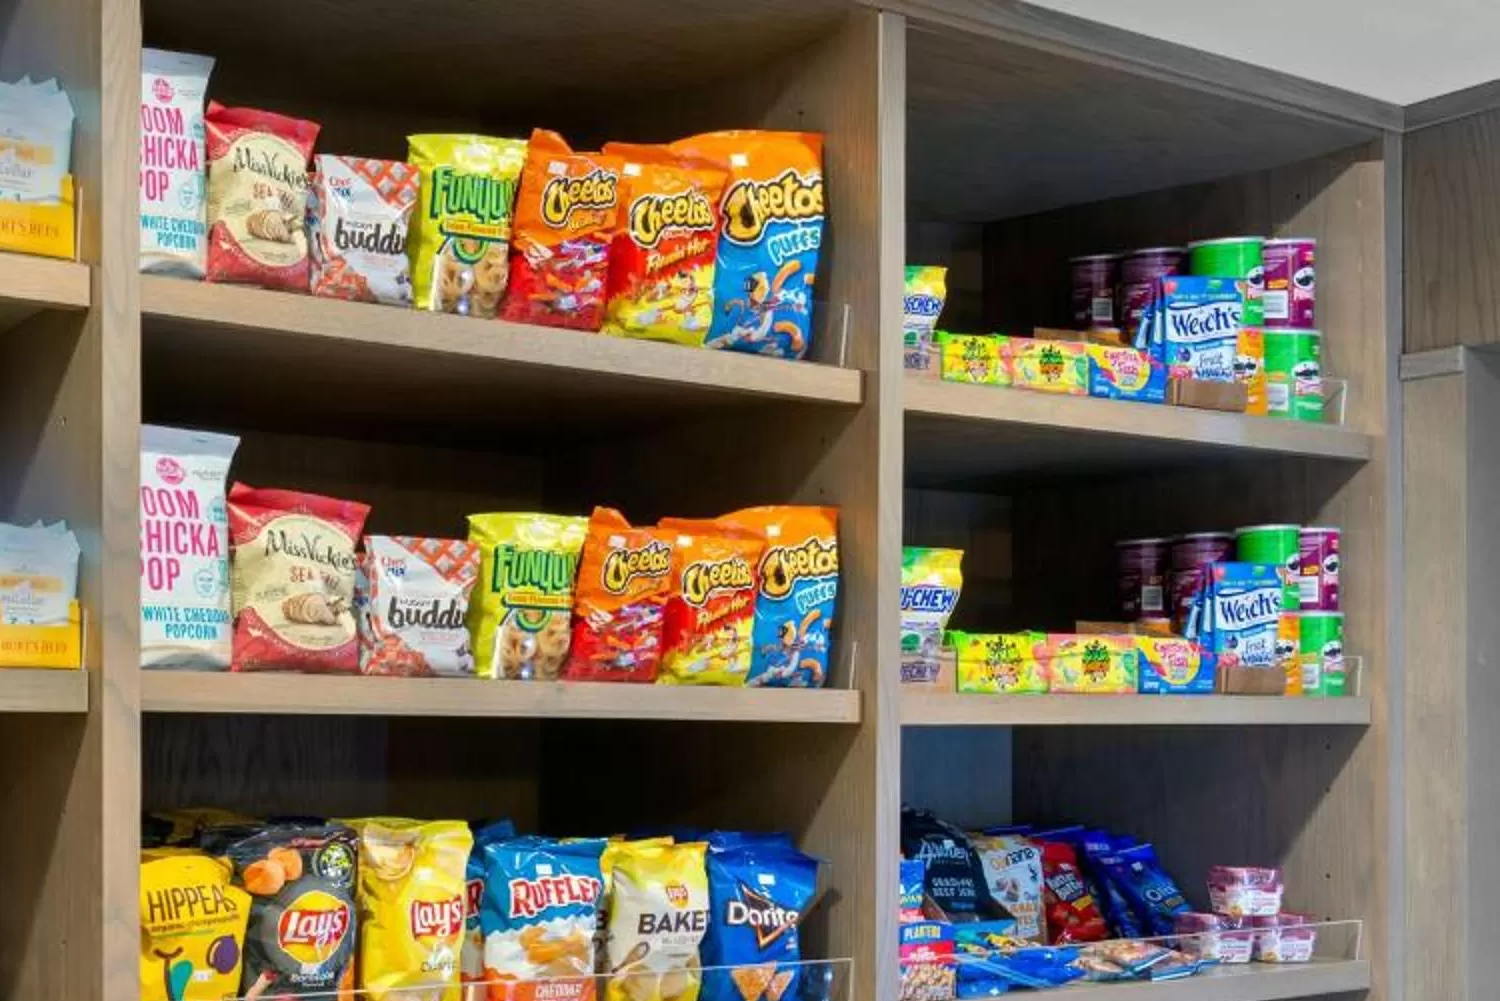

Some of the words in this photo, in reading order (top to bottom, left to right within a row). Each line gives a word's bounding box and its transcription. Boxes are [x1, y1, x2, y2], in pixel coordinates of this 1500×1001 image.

[142, 104, 184, 136] OOM
[141, 138, 199, 172] HICKA
[140, 170, 170, 202] OP
[544, 173, 617, 228] Cheetos
[630, 191, 713, 247] Cheetos
[723, 170, 824, 243] Cheetos
[29, 224, 61, 238] BEES
[767, 227, 821, 266] PUFFS
[1171, 306, 1241, 337] Welch's
[142, 485, 200, 522] OOM
[264, 528, 307, 557] Miss
[302, 533, 358, 573] Vickie's
[603, 547, 671, 594] Cheetos
[682, 562, 753, 606] Cheetos
[759, 538, 839, 599] Cheetos
[143, 606, 181, 623] WHITE
[797, 583, 837, 611] PUFFS
[1219, 590, 1280, 623] Welch's
[165, 623, 218, 641] POPCORN
[147, 883, 238, 924] HIPPEAS
[727, 900, 800, 929] Dorito
